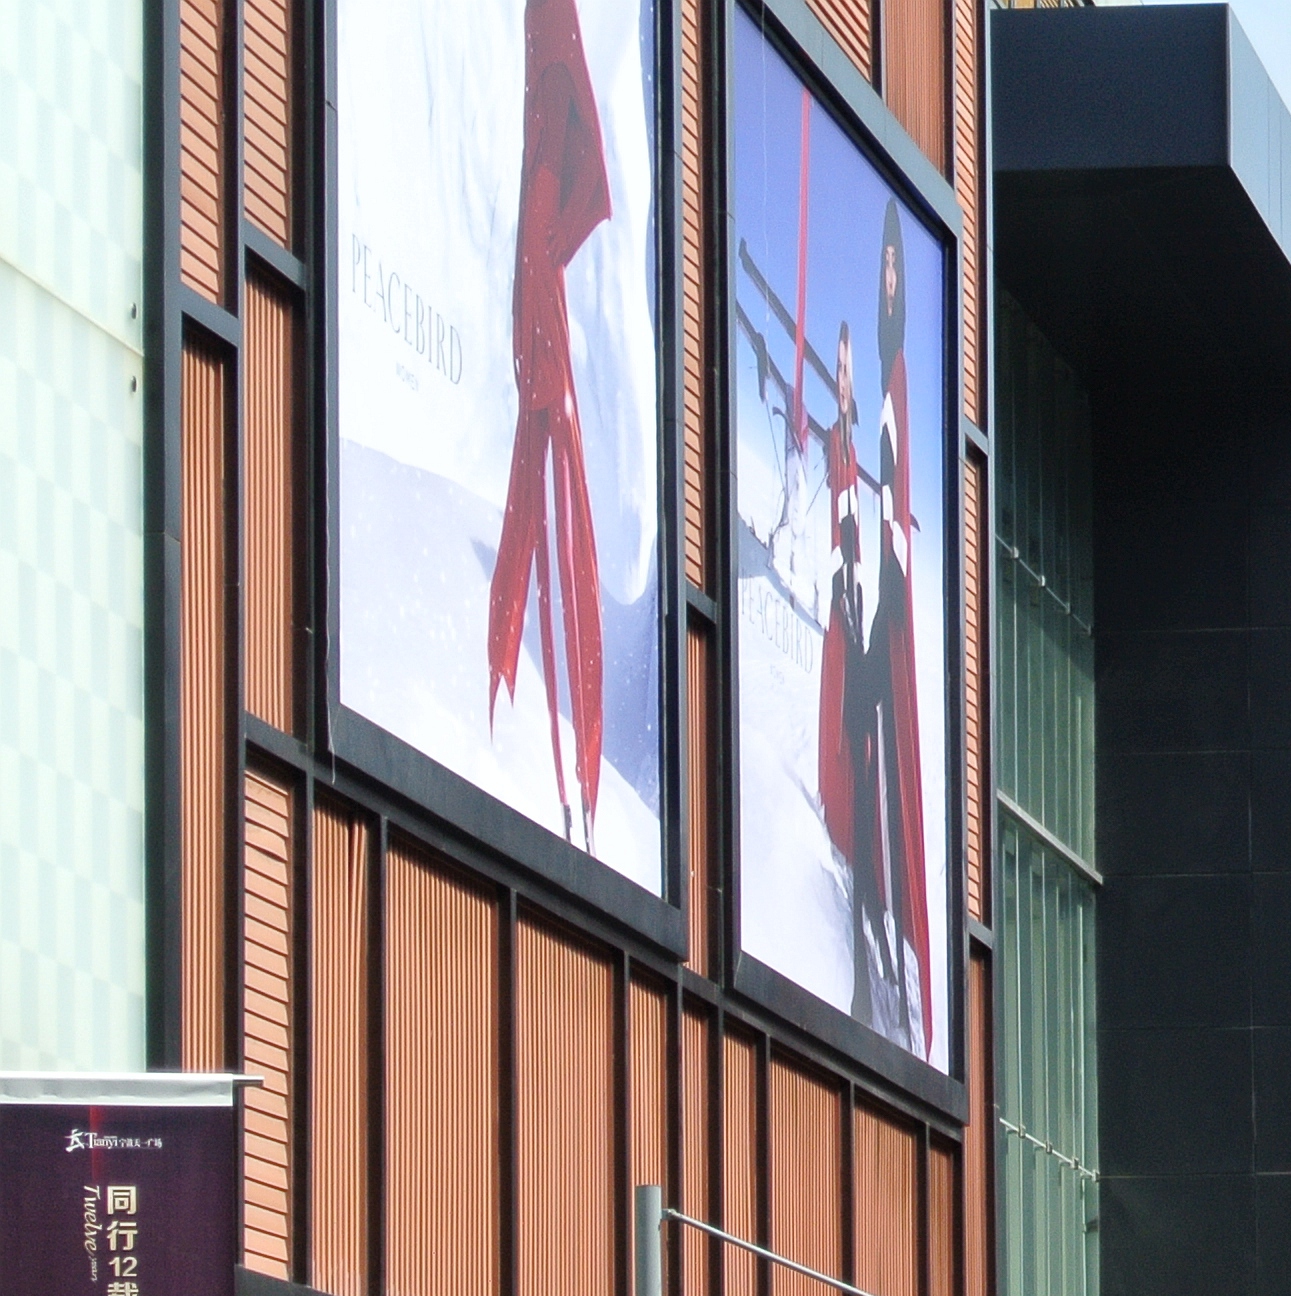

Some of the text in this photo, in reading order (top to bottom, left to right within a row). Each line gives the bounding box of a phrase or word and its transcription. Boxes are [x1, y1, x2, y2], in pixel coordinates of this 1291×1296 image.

[352, 233, 463, 385] PEACEBIRD
[741, 568, 814, 674] PEACEBIRD
[83, 1185, 102, 1257] Twelve
